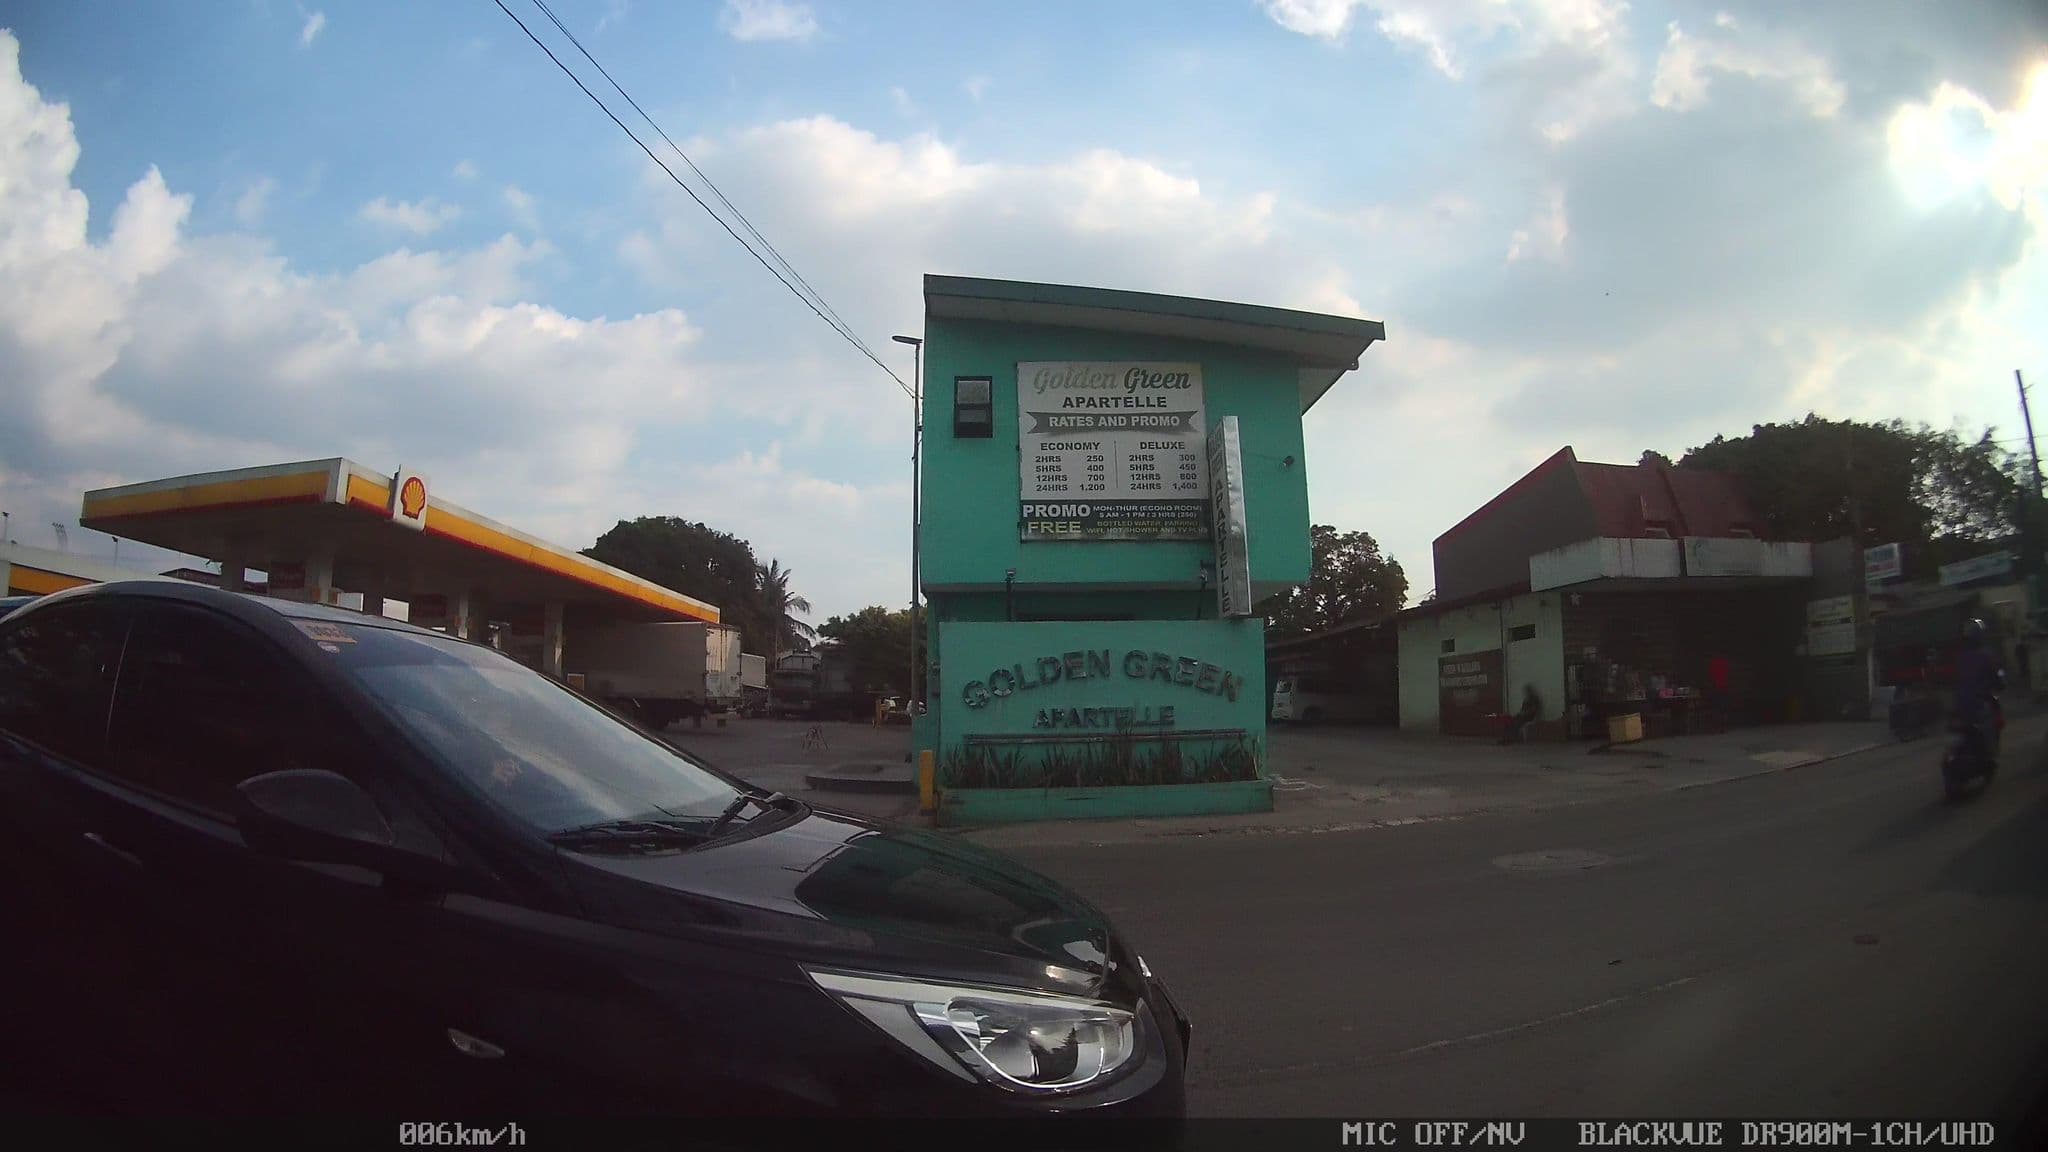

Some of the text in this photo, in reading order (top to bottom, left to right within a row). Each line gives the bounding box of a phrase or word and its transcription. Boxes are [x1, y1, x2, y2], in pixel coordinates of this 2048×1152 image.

[1034, 367, 1191, 394] Golden Green
[1062, 396, 1167, 408] APARTELLE
[1049, 415, 1180, 427] RATES AND PROMO
[1040, 442, 1100, 451] ECONOMY
[1139, 441, 1185, 450] DELUXE
[1179, 463, 1196, 471] 450
[1036, 474, 1068, 482] 12HRS
[1130, 473, 1161, 481] 12HRS
[1036, 484, 1068, 492] 24HRS
[1172, 482, 1197, 491] 1,400
[1022, 504, 1091, 518] PROMO
[1027, 521, 1082, 534] FREE
[962, 649, 1243, 709] GOLDEN GREEN
[1033, 705, 1176, 729] APARTELLE
